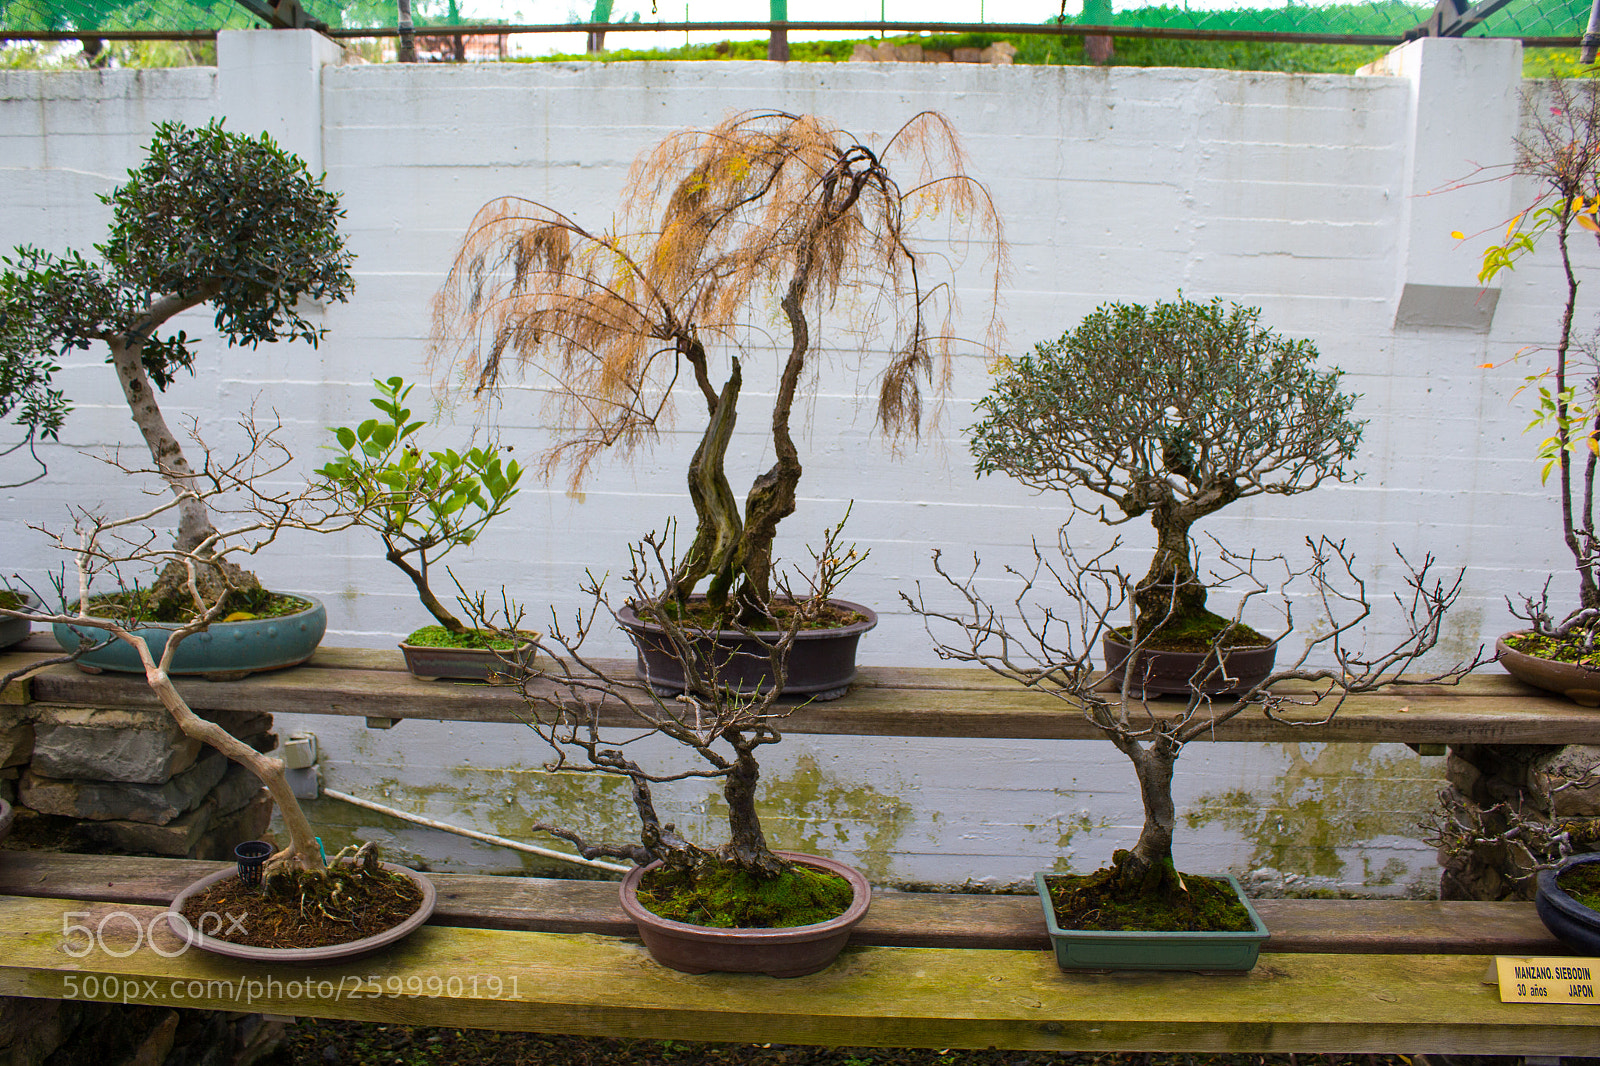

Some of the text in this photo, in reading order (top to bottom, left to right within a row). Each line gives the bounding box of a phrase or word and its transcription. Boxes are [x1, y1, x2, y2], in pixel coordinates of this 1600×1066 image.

[1514, 966, 1591, 980] MANZANO. SIEBODIN
[1517, 984, 1594, 997] 30 años JAPON
